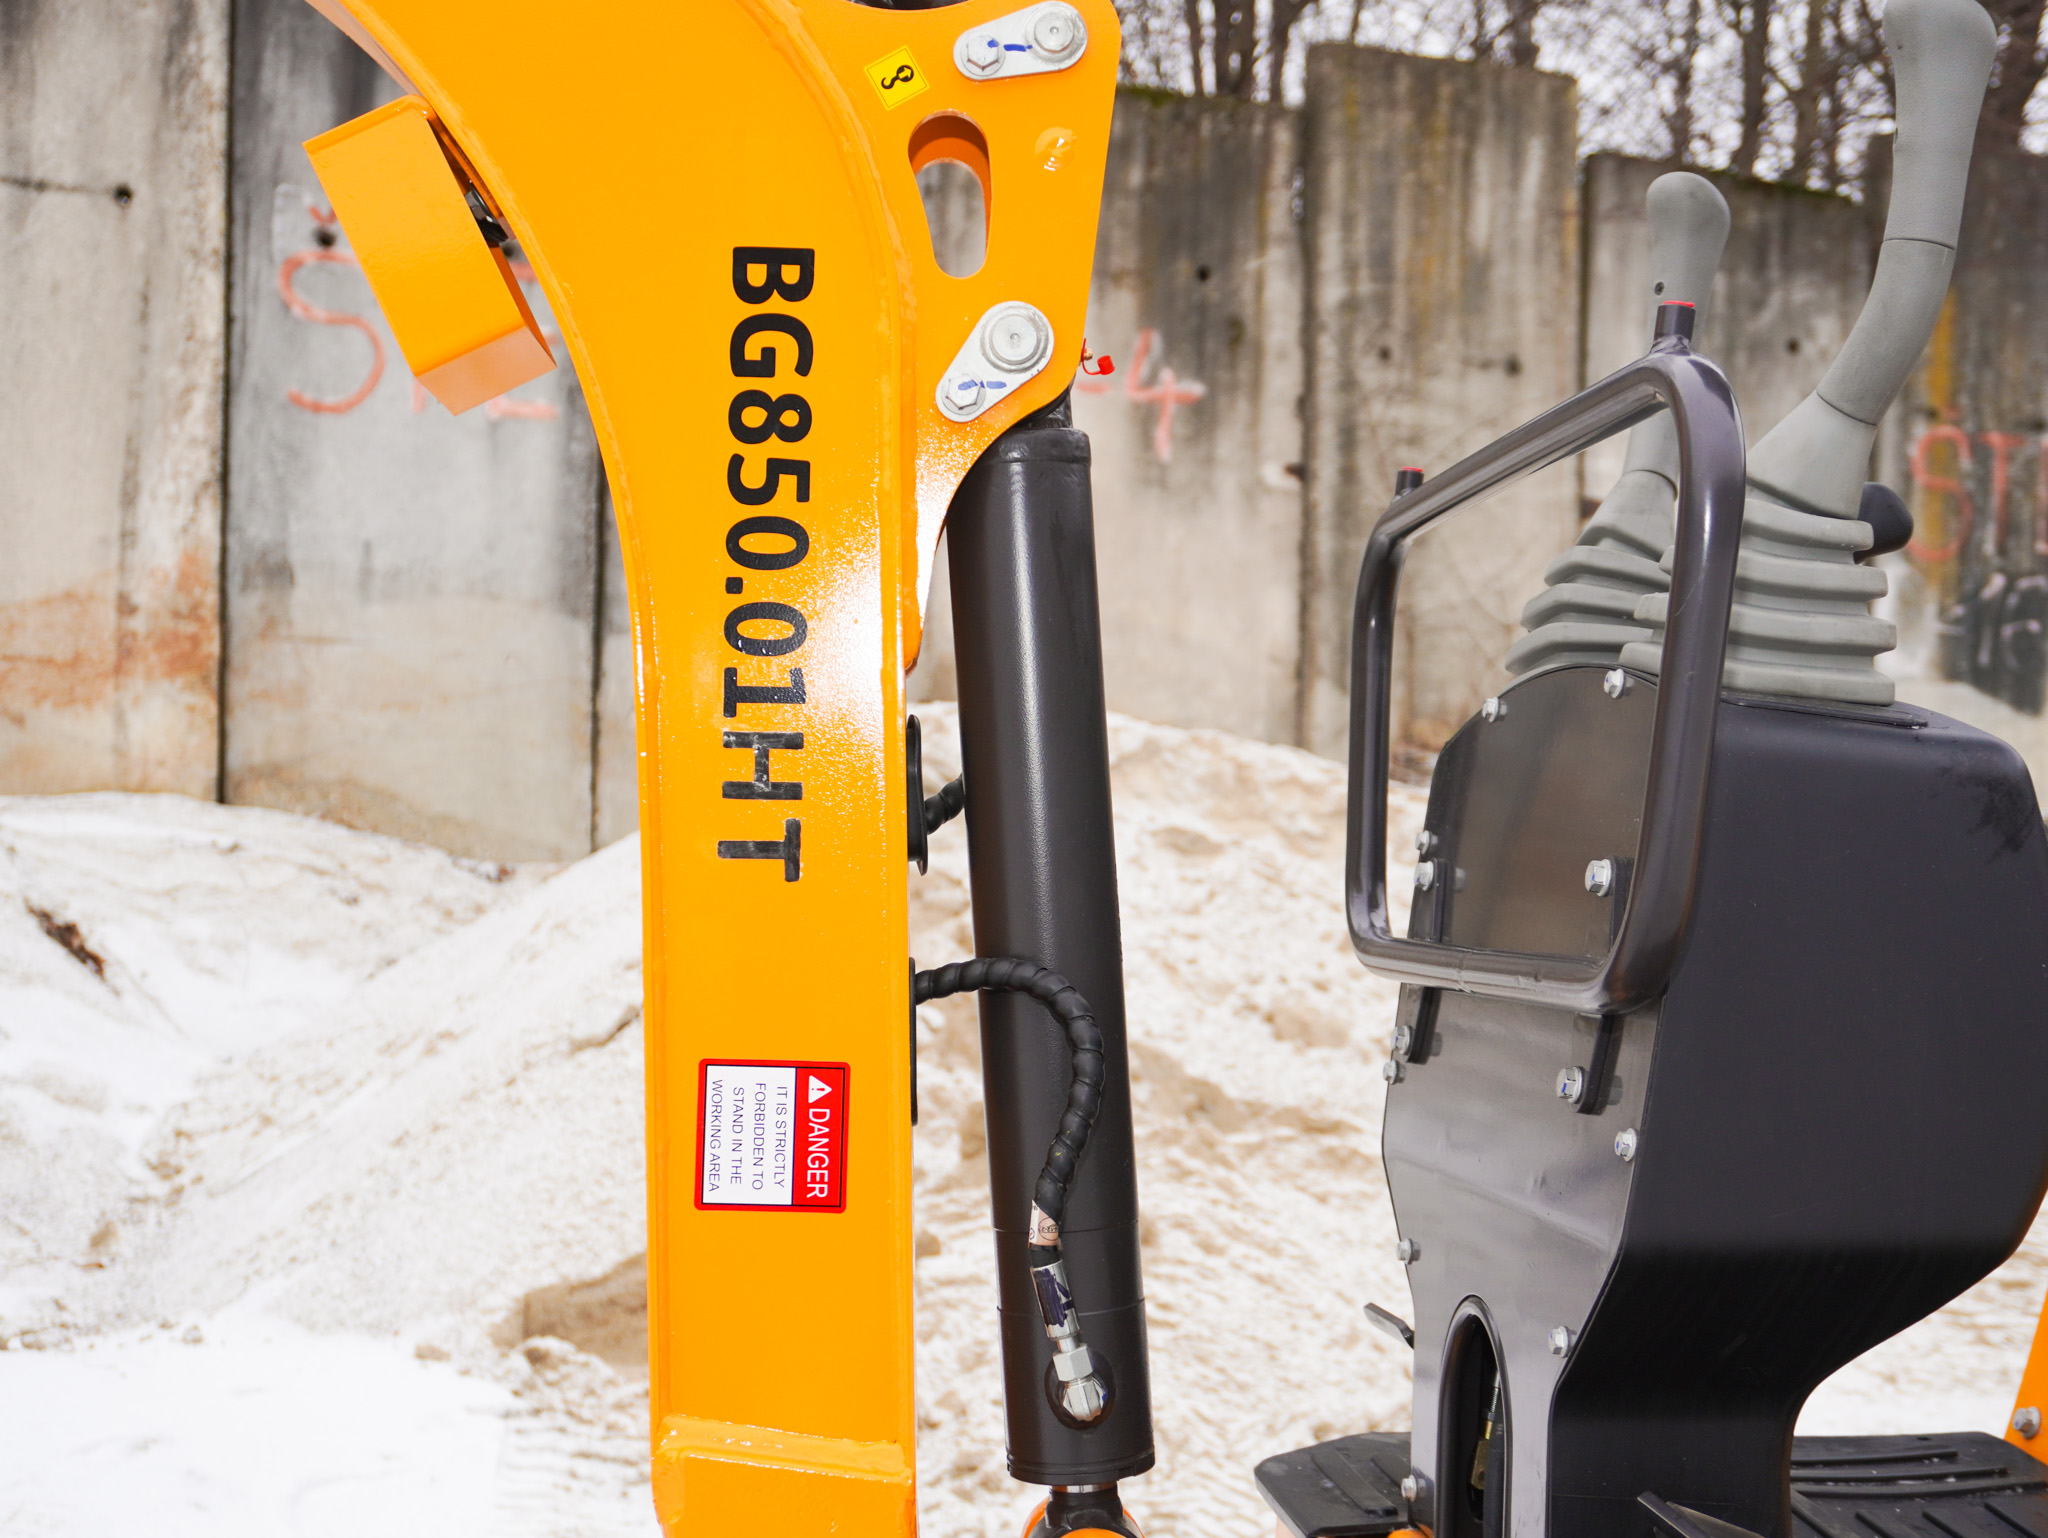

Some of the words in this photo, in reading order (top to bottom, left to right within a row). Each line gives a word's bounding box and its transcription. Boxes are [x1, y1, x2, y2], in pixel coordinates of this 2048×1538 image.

[717, 246, 815, 883] BG850.01HT
[732, 1087, 745, 1134] STAND
[775, 1103, 788, 1116] IS
[776, 1086, 788, 1098] IT
[709, 1079, 723, 1150] WORKING
[752, 1083, 767, 1167] FORBIDDEN
[731, 1139, 743, 1152] IN
[774, 1120, 787, 1188] STRICTLY
[806, 1108, 831, 1198] DANGER
[708, 1153, 721, 1192] AREA
[730, 1157, 743, 1185] THE
[752, 1171, 764, 1191] TO
